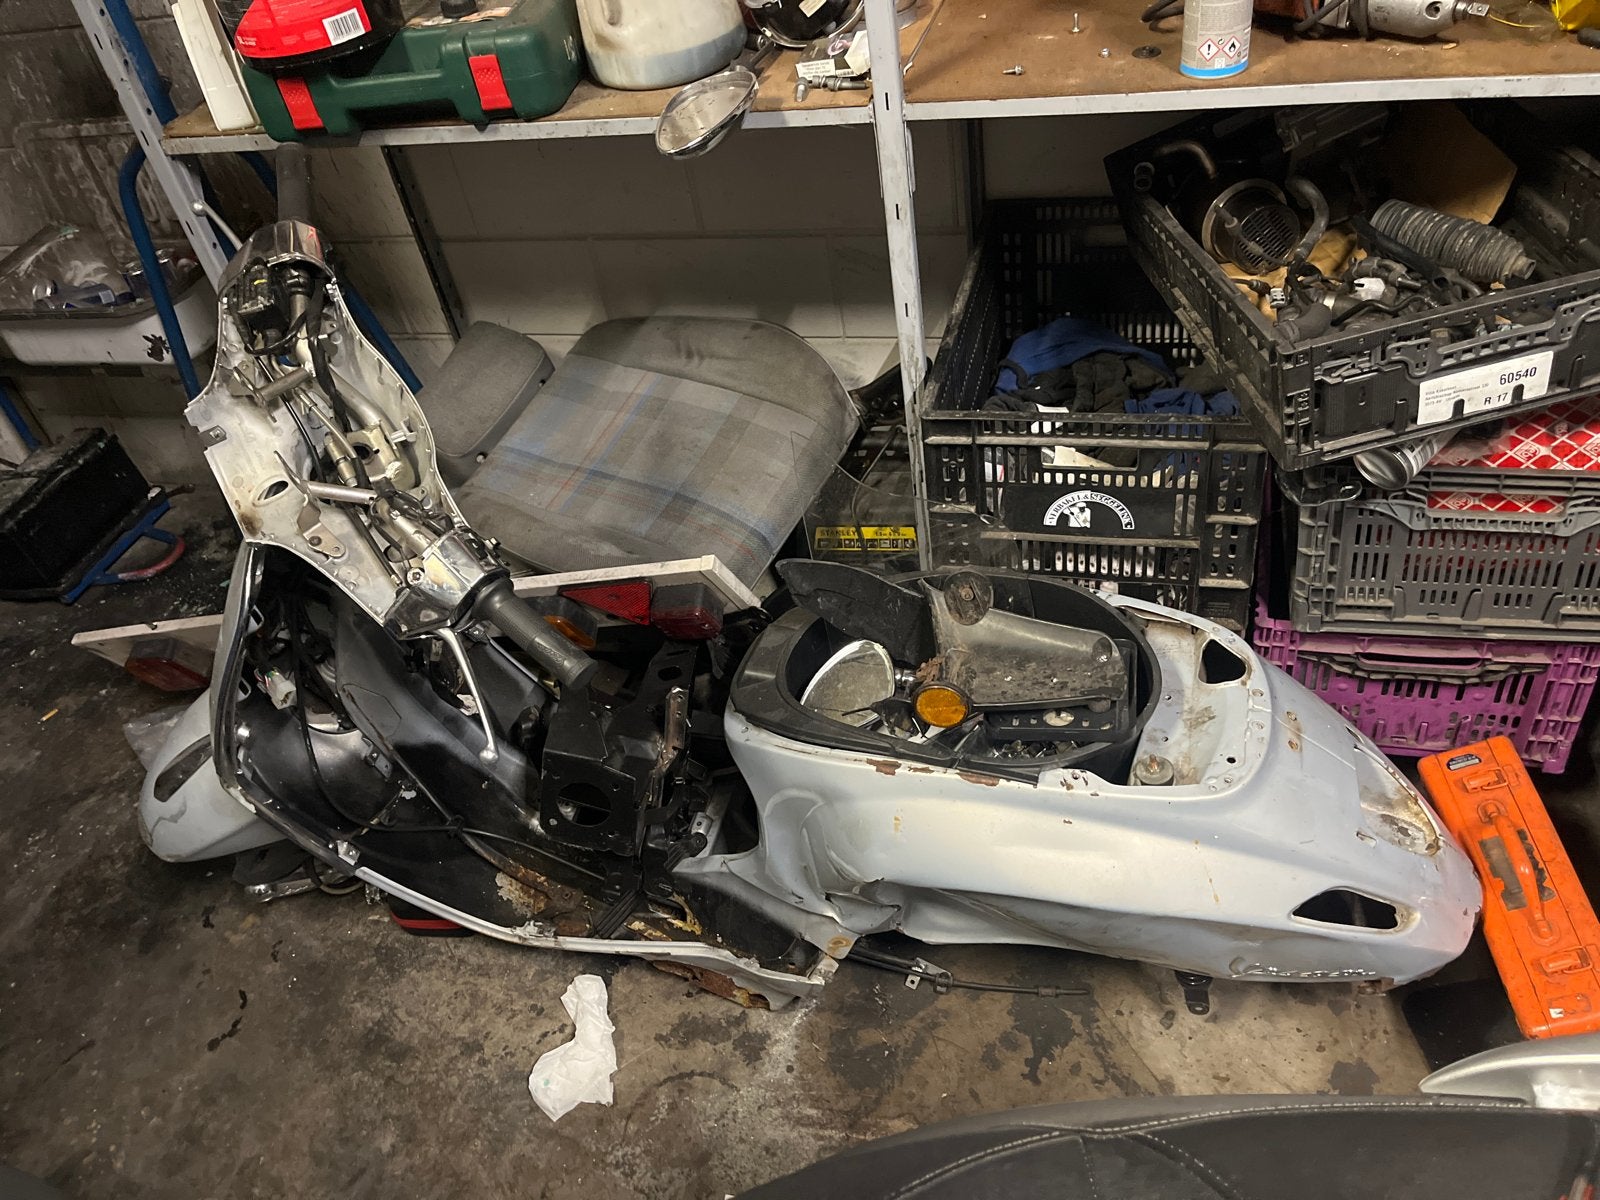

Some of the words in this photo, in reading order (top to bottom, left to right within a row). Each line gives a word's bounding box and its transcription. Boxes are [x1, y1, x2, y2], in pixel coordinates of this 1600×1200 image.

[1499, 367, 1537, 385] 60540
[1484, 396, 1492, 405] R
[1497, 392, 1508, 402] 17
